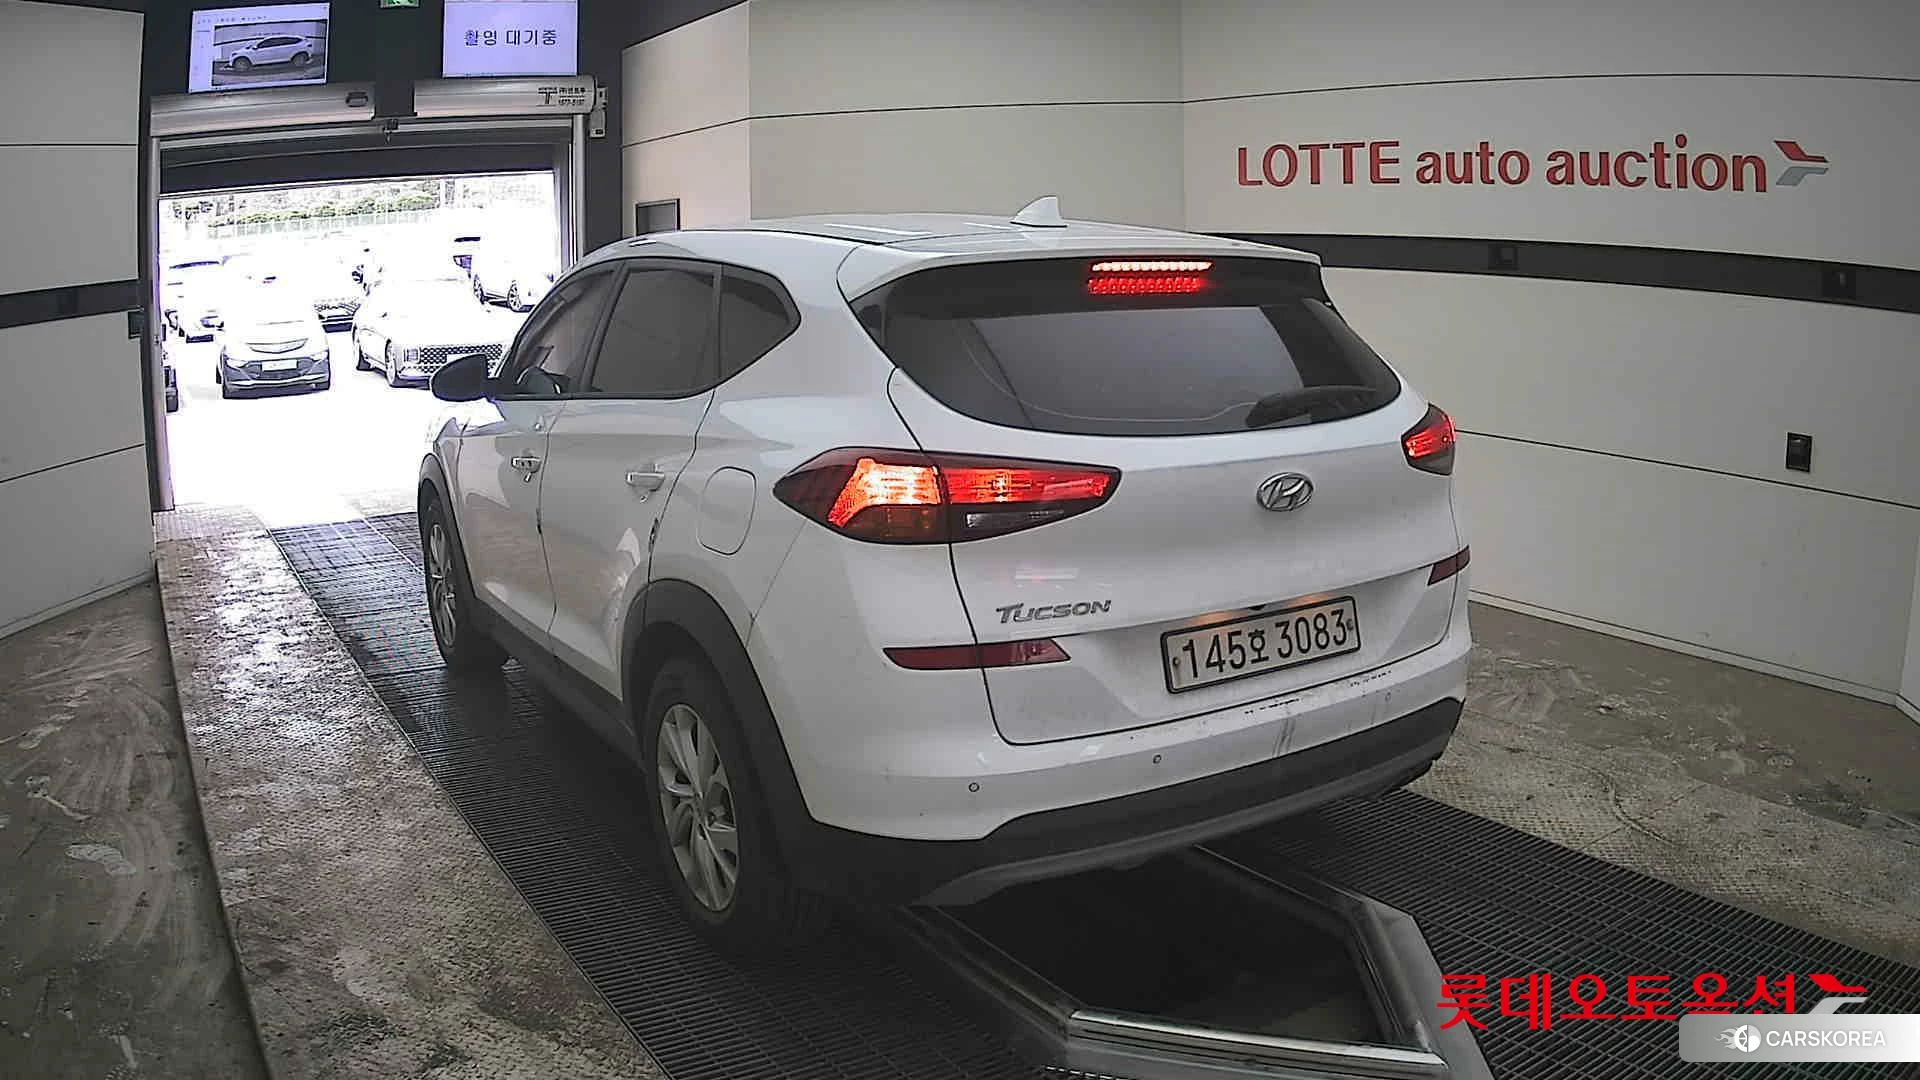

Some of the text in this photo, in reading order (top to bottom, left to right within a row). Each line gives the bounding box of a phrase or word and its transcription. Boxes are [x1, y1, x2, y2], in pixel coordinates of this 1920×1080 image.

[464, 29, 557, 46] 촬영 대기중
[1238, 133, 1767, 193] LOTTE auto auction
[995, 600, 1111, 623] TUCSON
[1182, 609, 1348, 679] 145호 3083
